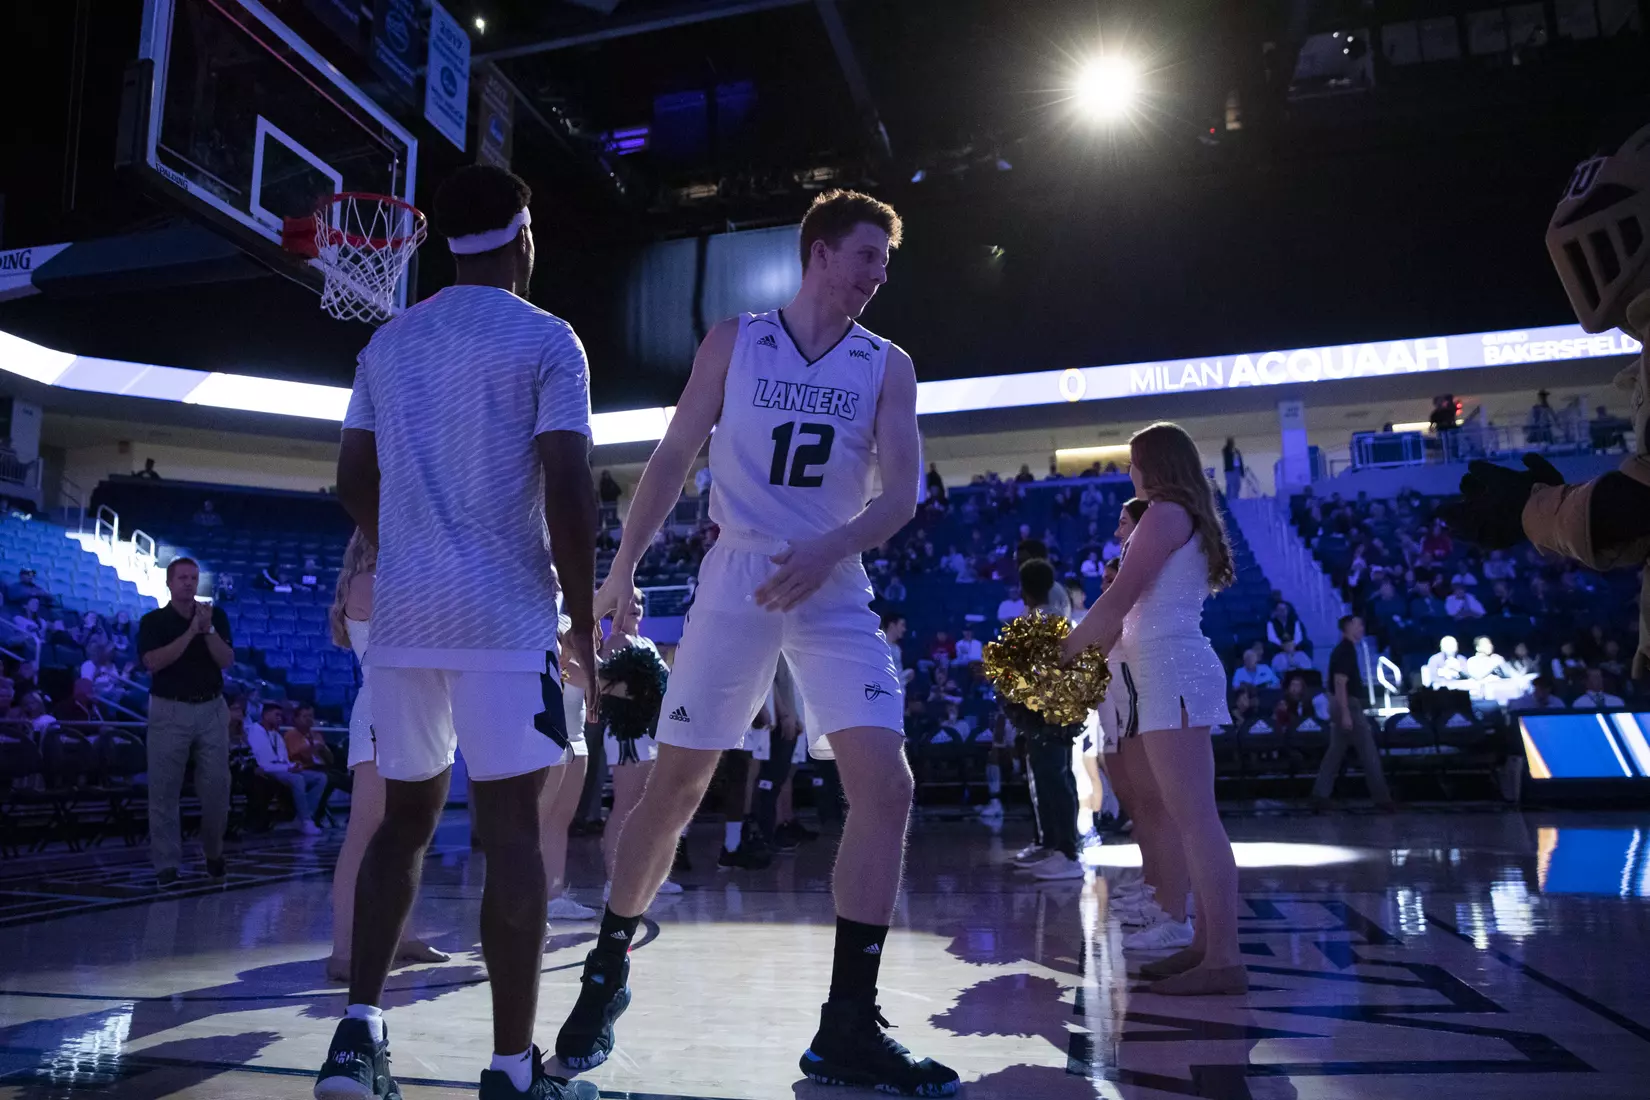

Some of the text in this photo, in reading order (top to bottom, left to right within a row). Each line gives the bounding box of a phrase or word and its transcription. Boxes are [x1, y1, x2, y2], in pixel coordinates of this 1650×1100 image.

[0, 249, 32, 270] ING
[849, 349, 871, 361] WAC
[1130, 361, 1224, 393] MILAN
[1228, 337, 1450, 388] ACQUAAH
[1484, 334, 1641, 365] BAKERSFIELD
[752, 378, 859, 421] LANCERS
[769, 421, 835, 488] 12
